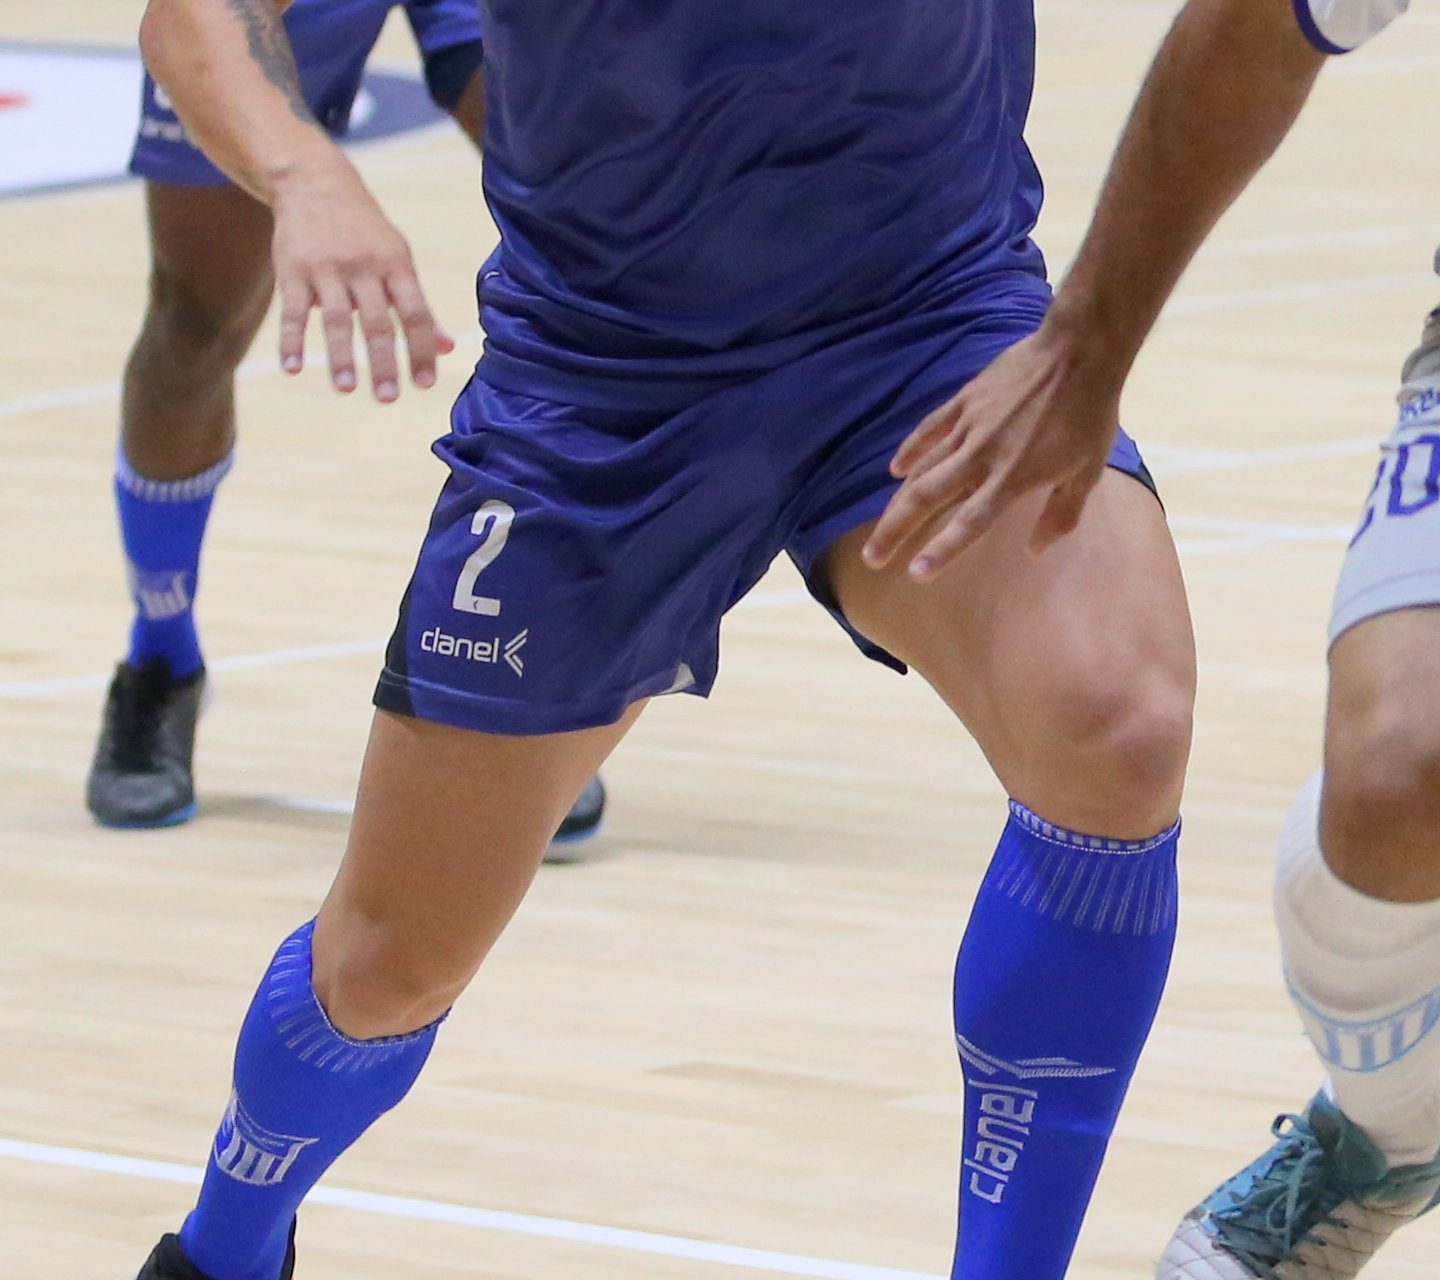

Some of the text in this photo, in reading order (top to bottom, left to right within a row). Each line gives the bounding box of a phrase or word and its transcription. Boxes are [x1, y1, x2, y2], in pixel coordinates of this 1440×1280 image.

[452, 498, 516, 617] 2
[420, 626, 500, 664] clanel
[964, 1077, 1040, 1204] clanel
